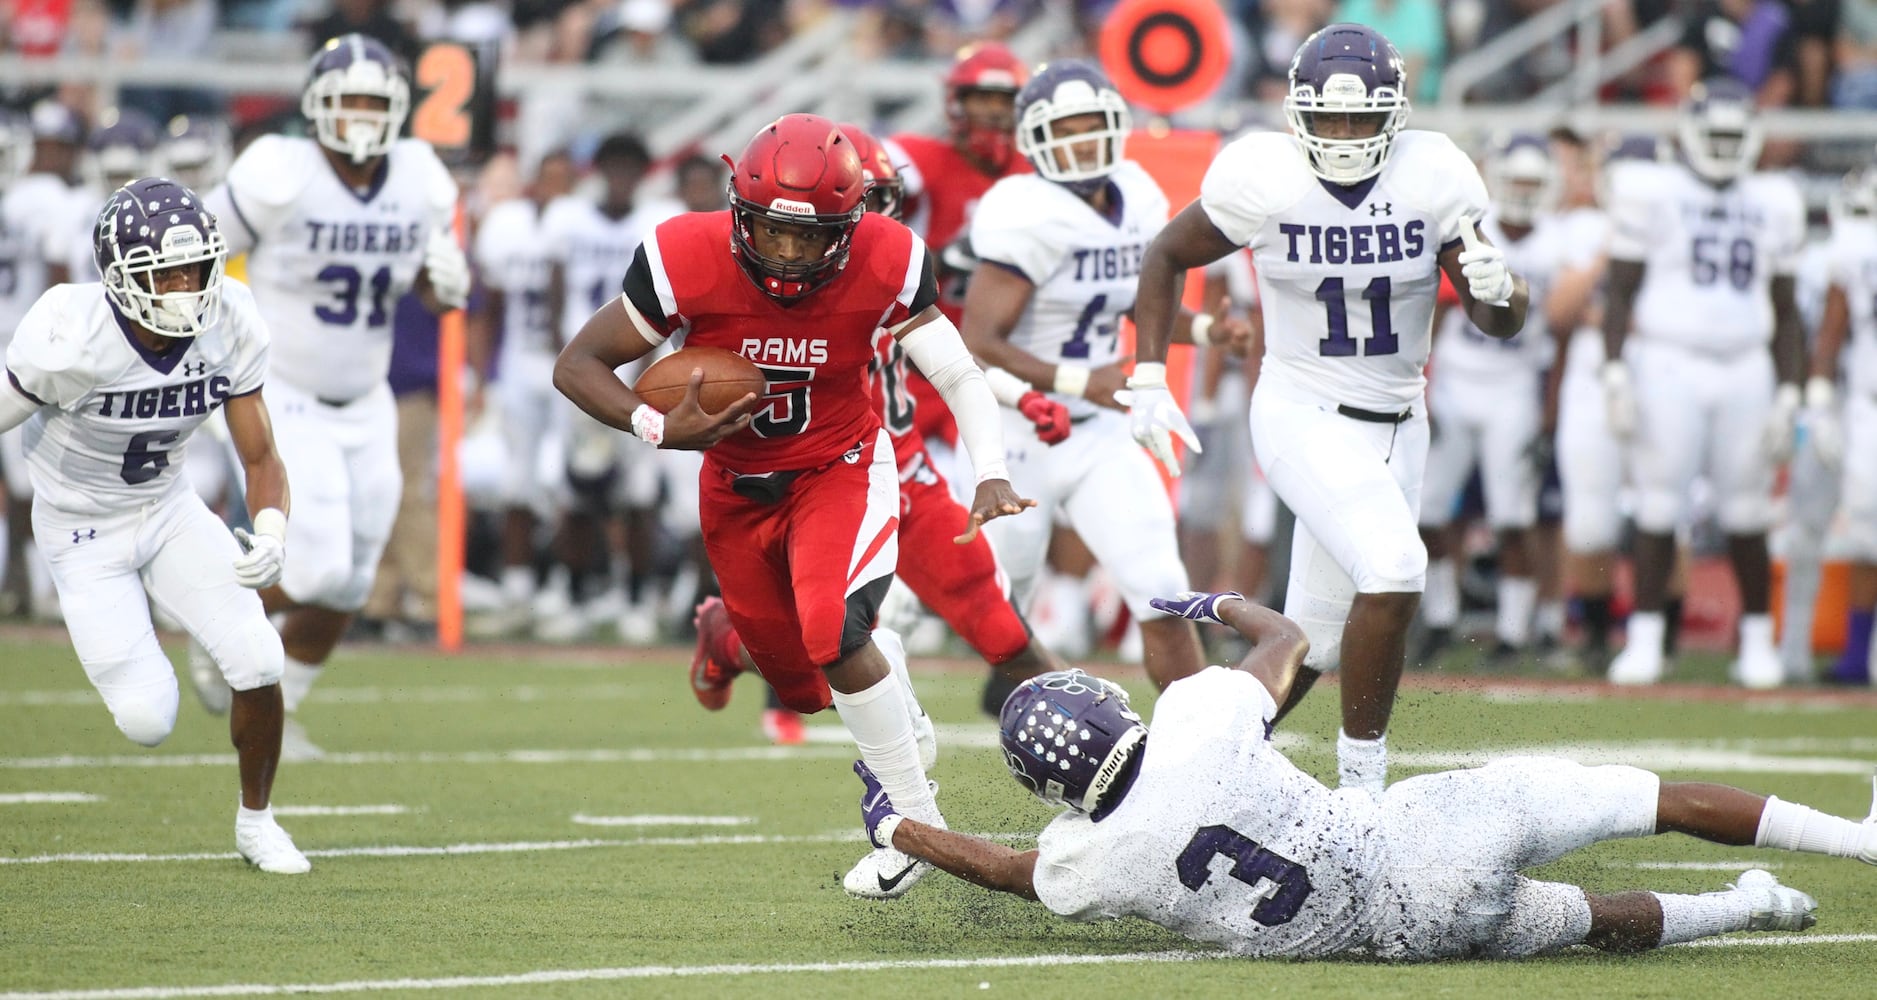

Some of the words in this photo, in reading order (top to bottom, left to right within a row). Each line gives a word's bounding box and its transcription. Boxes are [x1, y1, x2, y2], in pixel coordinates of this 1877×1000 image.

[411, 43, 474, 148] 2
[776, 202, 811, 214] Riddell
[305, 220, 420, 253] TIGERS
[1279, 219, 1425, 264] TIGERS
[314, 264, 392, 328] 31
[1315, 276, 1399, 357] 11
[739, 337, 829, 364] RAMS
[98, 375, 231, 419] TIGERS
[751, 362, 817, 439] 5
[120, 429, 181, 486] 6
[1095, 748, 1125, 791] schutt
[1175, 823, 1316, 927] 3
